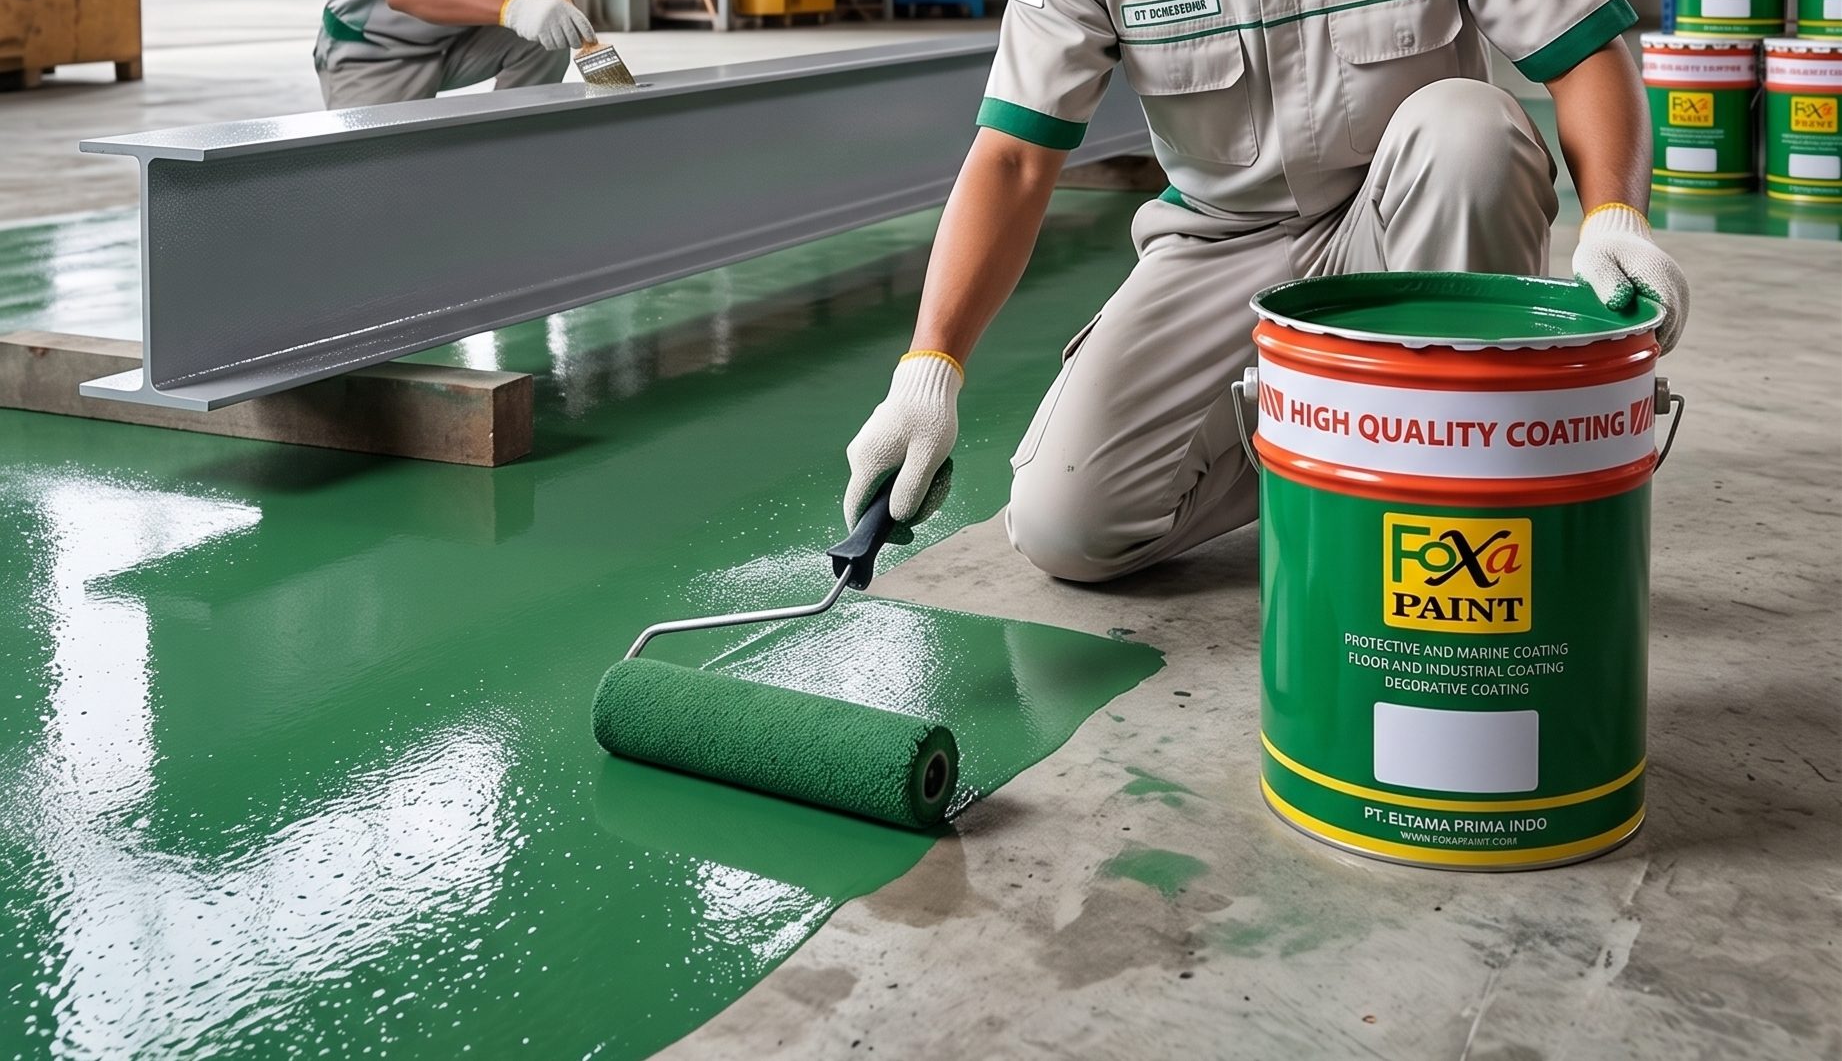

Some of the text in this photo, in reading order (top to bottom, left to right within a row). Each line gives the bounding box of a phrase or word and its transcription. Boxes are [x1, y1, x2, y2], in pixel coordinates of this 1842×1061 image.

[1290, 399, 1625, 448] HIGH QUALITY COATING
[1391, 591, 1524, 623] PAINT
[1344, 632, 1569, 660] PROTECTIVE AND MARINE COATING
[1348, 651, 1565, 678] FLOOR AND INDUSTRIAL COATING
[1471, 683, 1529, 696] COATING
[1364, 806, 1547, 833] PT. ELTAMA PRIMA INDO
